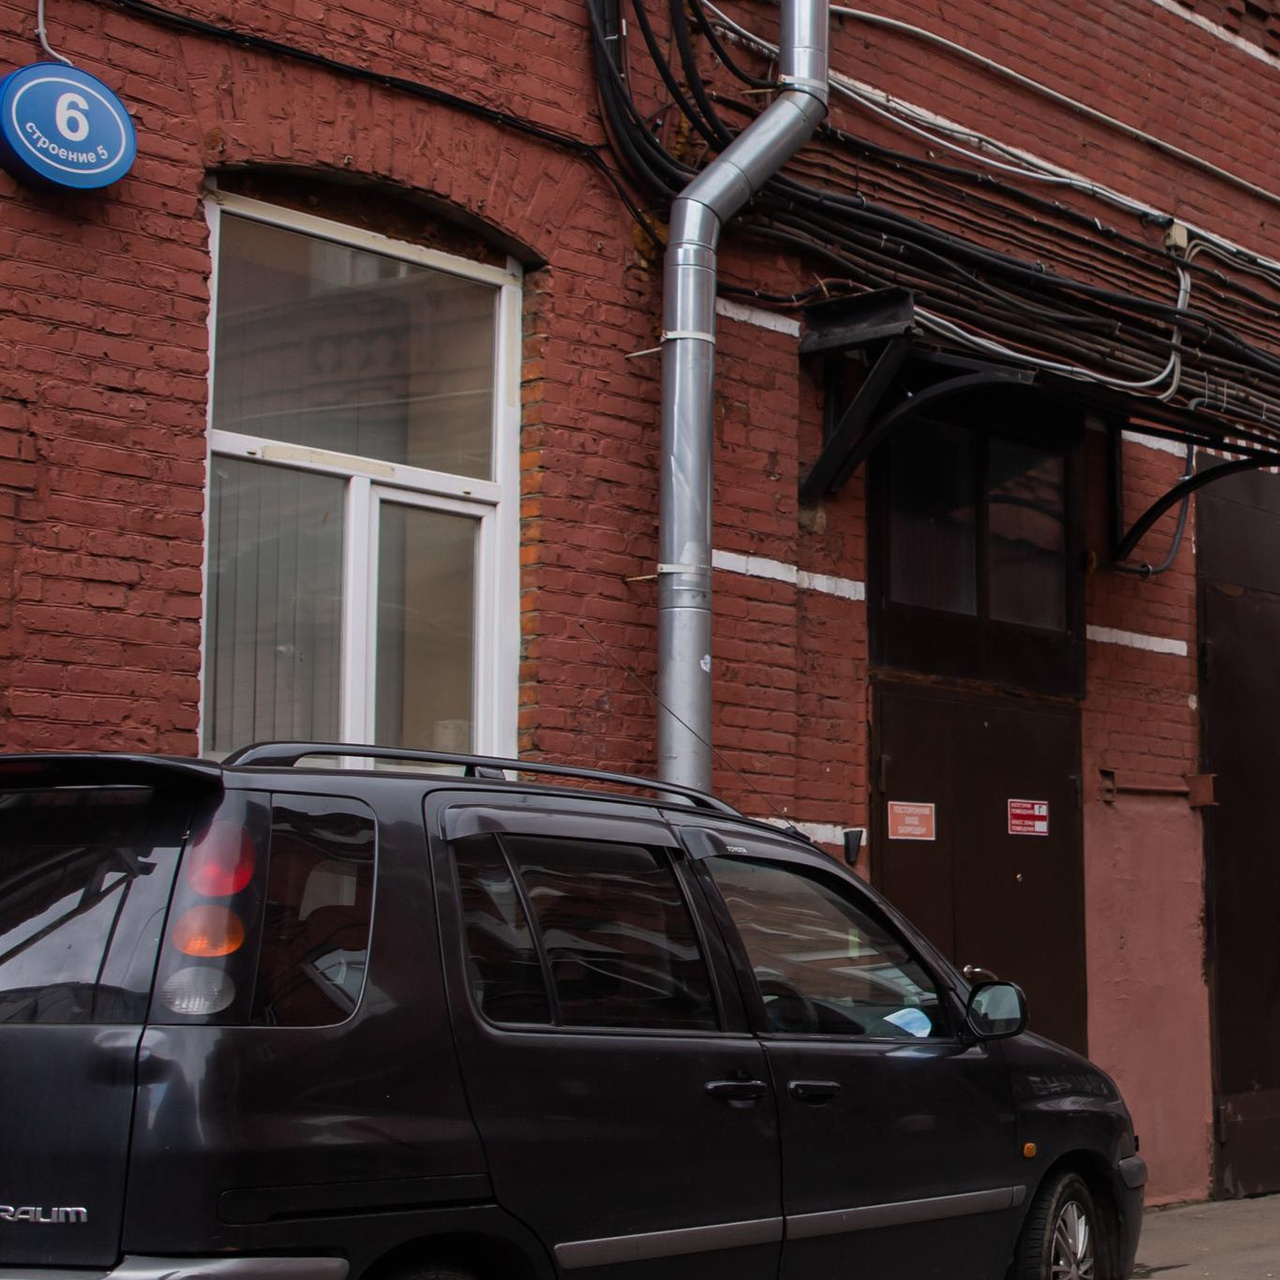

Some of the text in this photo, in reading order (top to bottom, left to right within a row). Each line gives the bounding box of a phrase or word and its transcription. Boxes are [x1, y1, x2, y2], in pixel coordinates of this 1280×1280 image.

[56, 92, 89, 141] 6
[26, 122, 108, 163] строение 5
